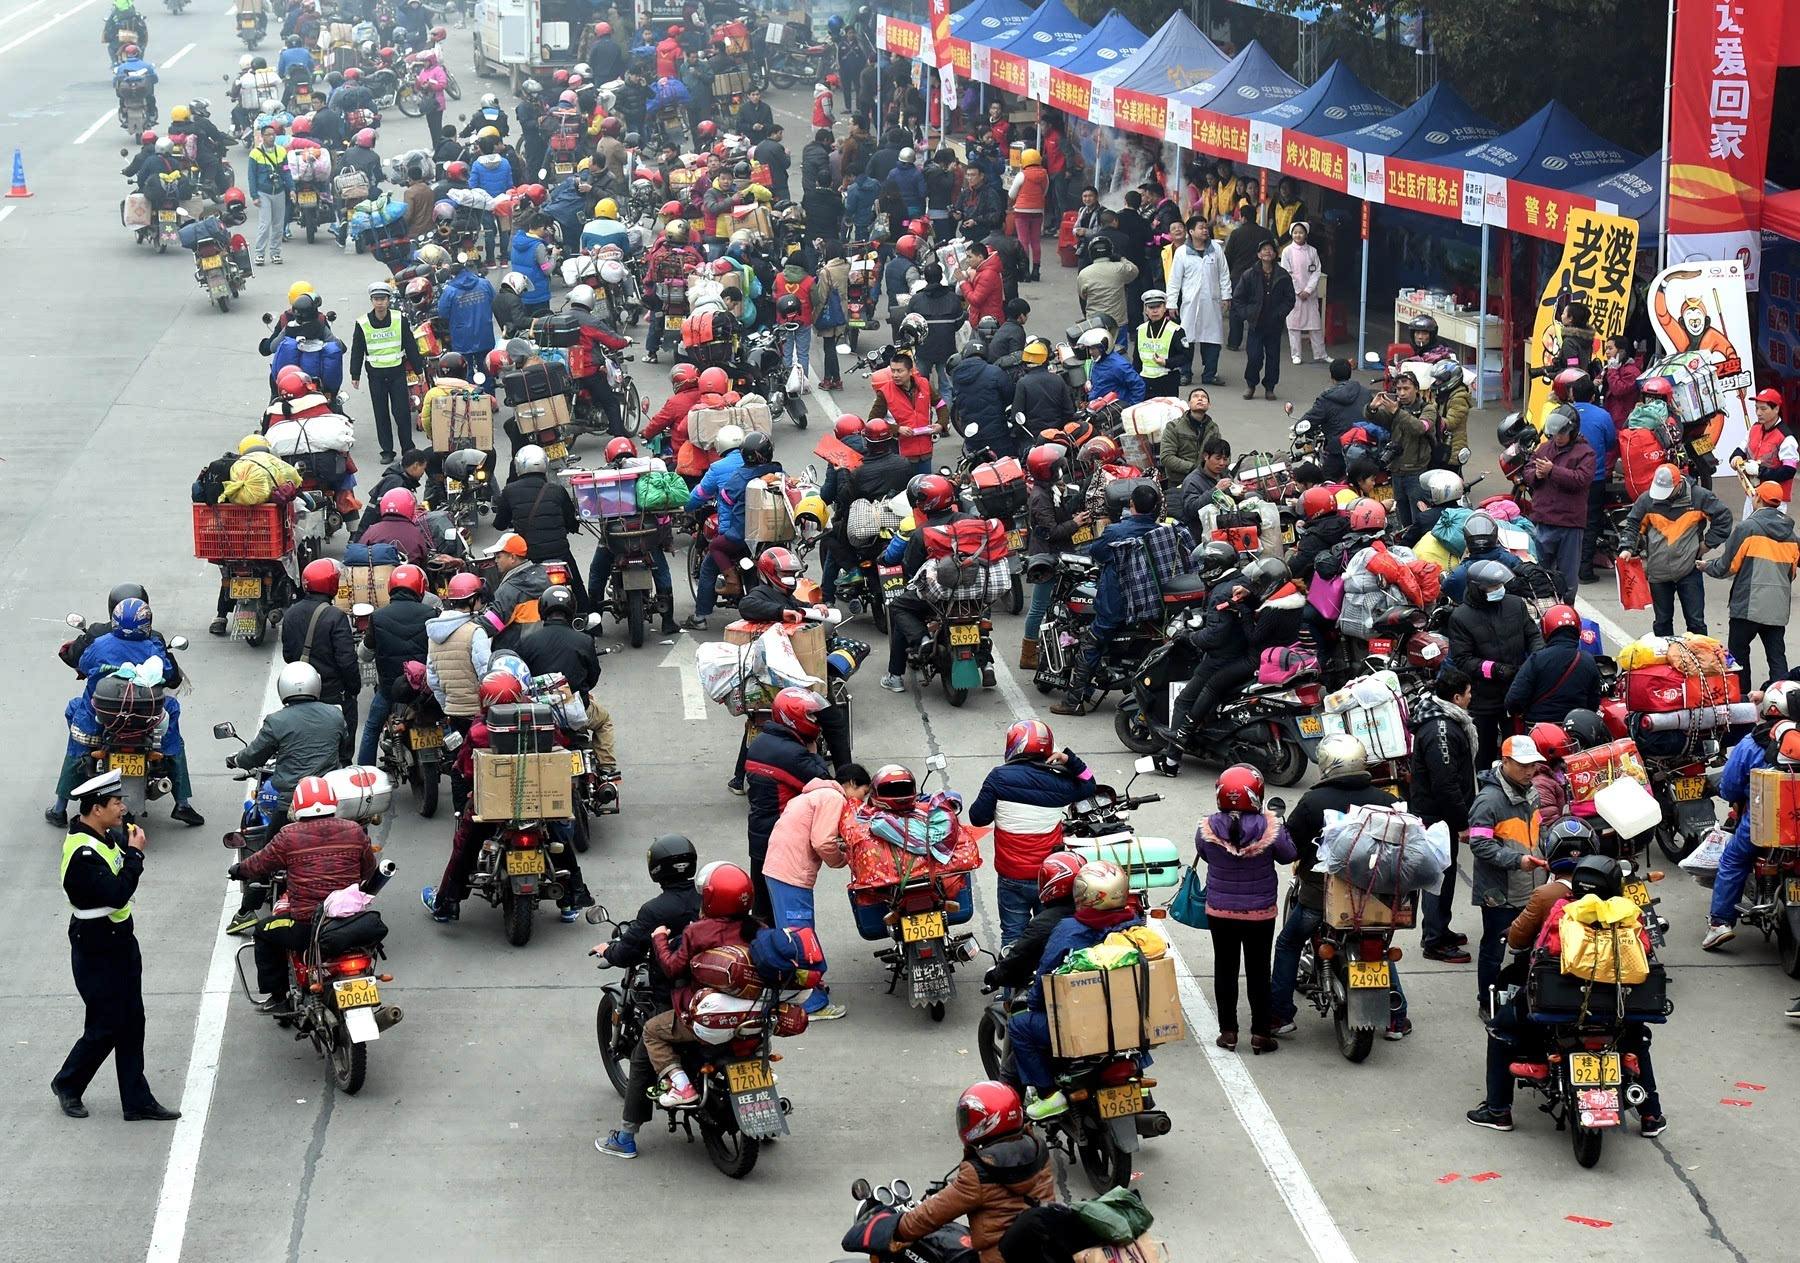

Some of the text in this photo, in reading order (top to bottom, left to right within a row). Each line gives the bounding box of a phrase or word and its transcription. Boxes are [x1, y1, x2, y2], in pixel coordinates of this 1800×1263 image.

[993, 59, 1026, 87] 工会服务点
[1192, 119, 1248, 153] 工会热水供应点
[1286, 140, 1344, 180] 烤火取暖点
[1569, 150, 1622, 160] 中国移动
[1388, 170, 1459, 207] 卫生医疗服务点
[1570, 219, 1635, 297] 老婆
[1437, 720, 1450, 764] adidas
[117, 755, 138, 764] 桂·R
[510, 862, 543, 873] 550E6
[911, 915, 934, 927] 桂·A
[339, 990, 378, 1007] 9084H
[736, 1062, 761, 1074] 桂·R
[1103, 1097, 1141, 1117] Y963F
